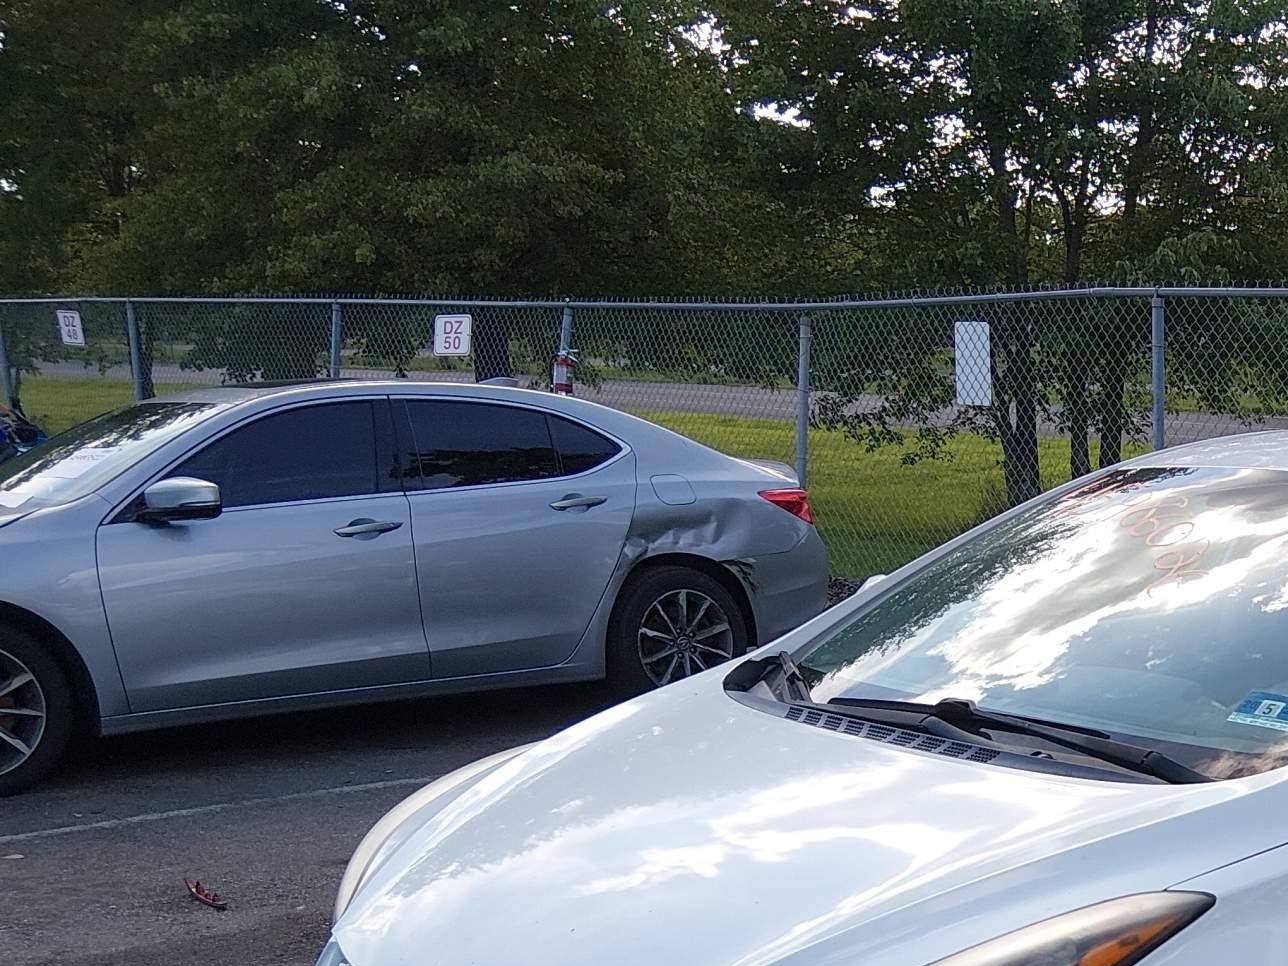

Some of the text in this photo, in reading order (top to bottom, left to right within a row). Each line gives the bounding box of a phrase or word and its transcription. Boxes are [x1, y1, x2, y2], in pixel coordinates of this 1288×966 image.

[63, 315, 77, 328] DZ
[443, 320, 464, 335] DZ
[443, 335, 462, 350] 50
[1262, 703, 1277, 715] 5
